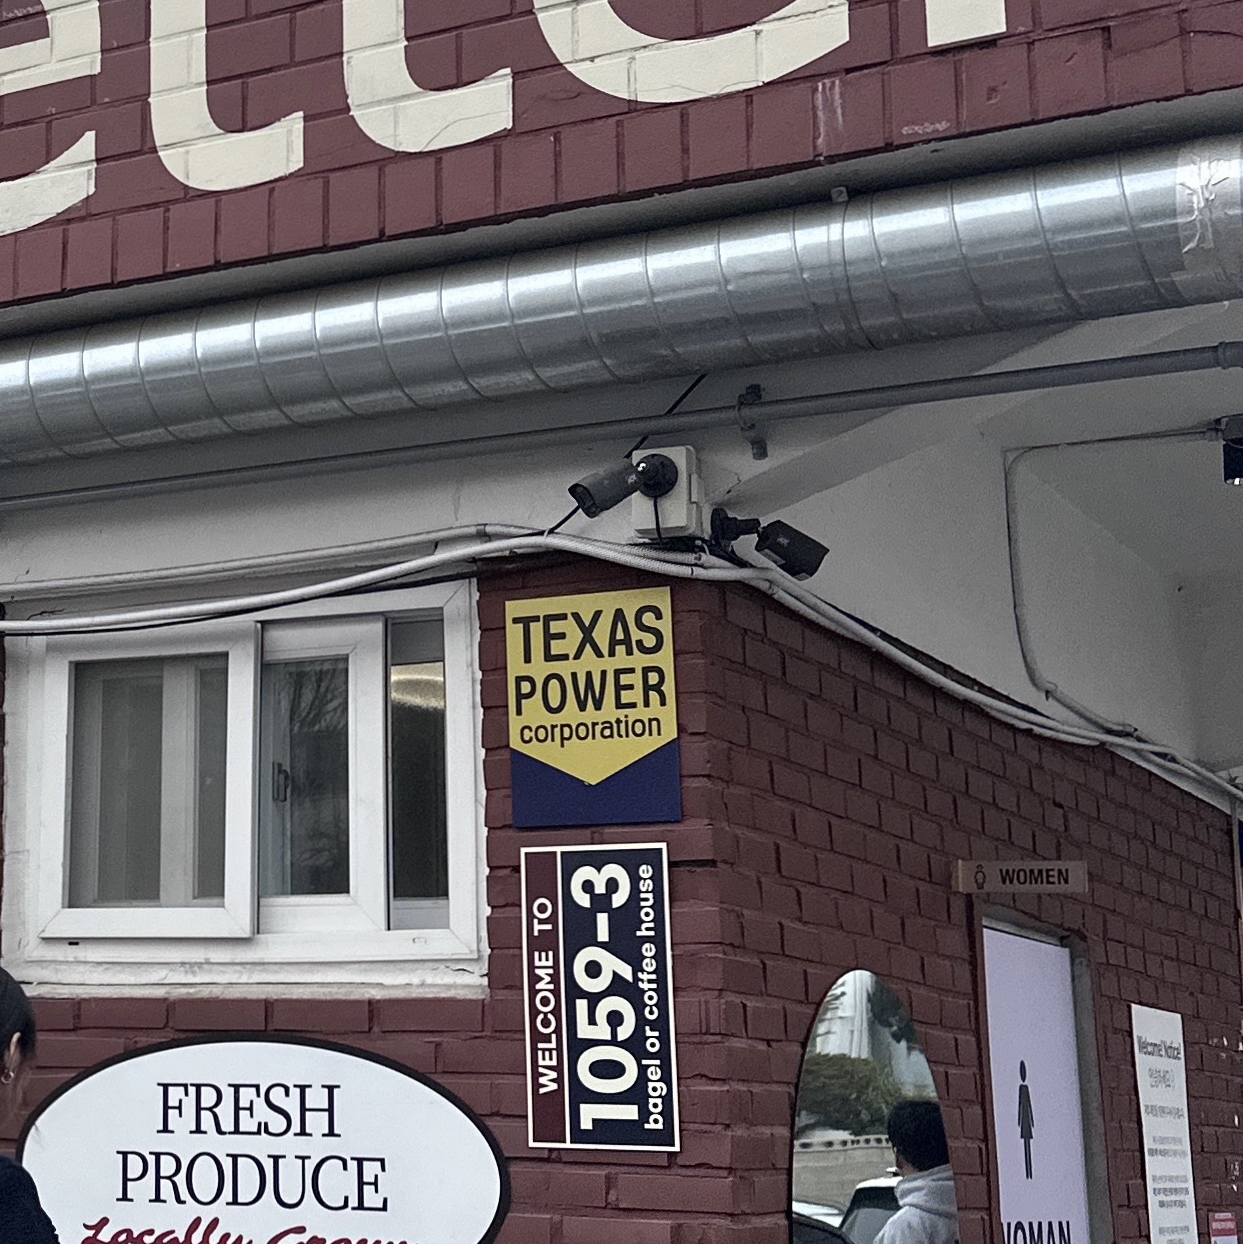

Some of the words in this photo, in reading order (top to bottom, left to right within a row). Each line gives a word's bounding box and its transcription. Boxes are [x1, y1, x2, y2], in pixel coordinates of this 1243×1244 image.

[512, 604, 664, 664] TEXAS
[515, 665, 667, 716] POWER
[520, 714, 662, 748] corporation
[636, 864, 655, 937] house
[999, 867, 1070, 886] WOMEN
[533, 897, 553, 937] TO
[570, 863, 639, 1130] 1059-3
[638, 943, 659, 1021] coffee
[534, 950, 559, 1094] WELCOME
[645, 1026, 661, 1053] or
[156, 1082, 341, 1138] FRESH
[642, 1060, 667, 1130] bagel
[115, 1150, 388, 1212] PRODUCE
